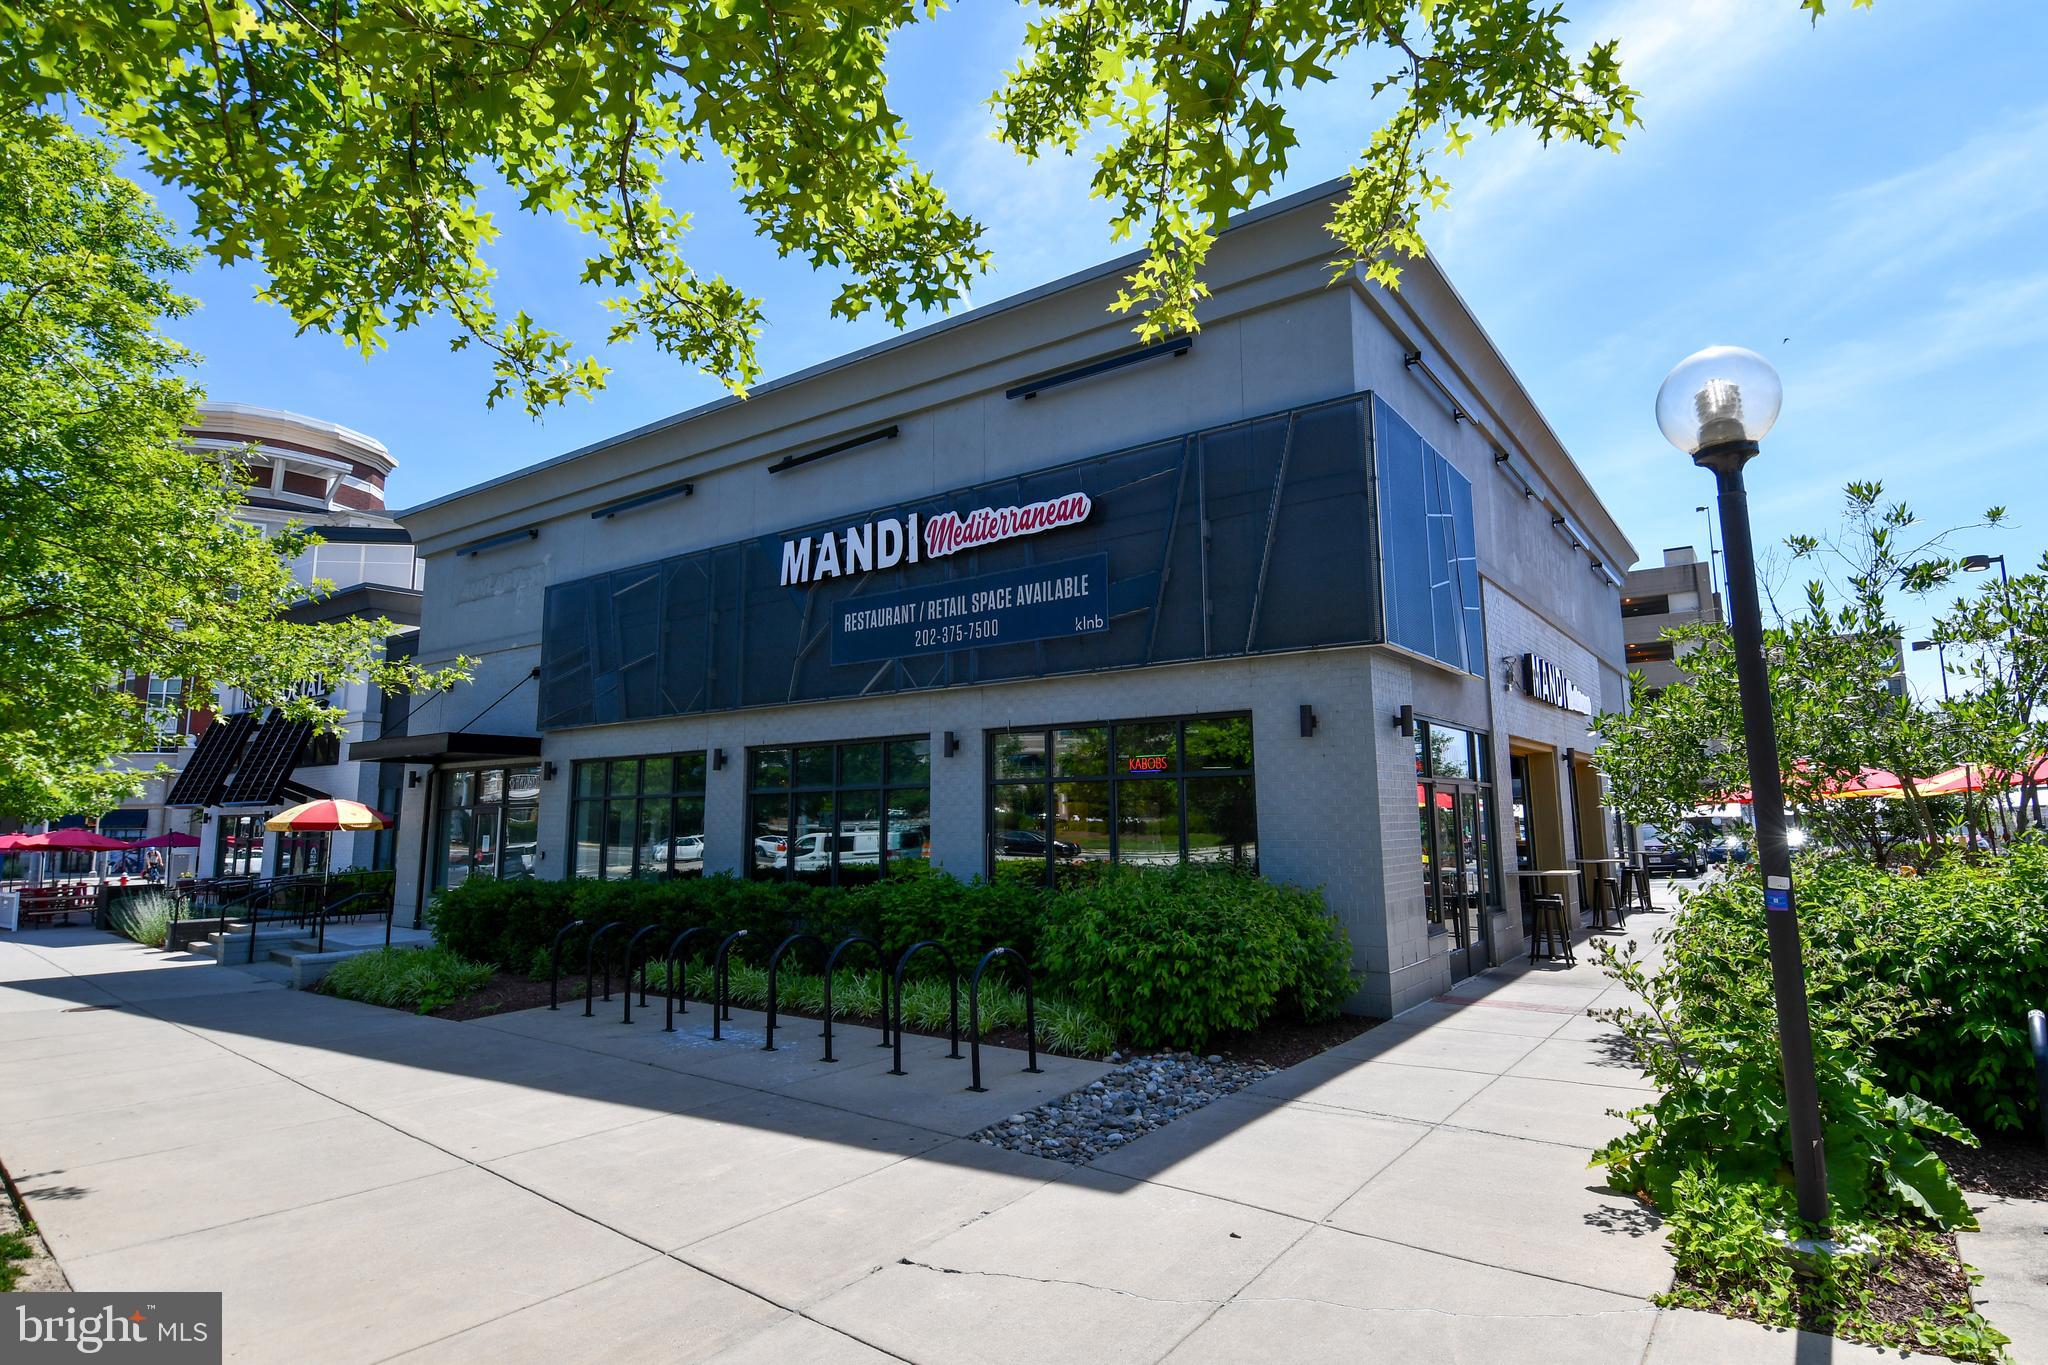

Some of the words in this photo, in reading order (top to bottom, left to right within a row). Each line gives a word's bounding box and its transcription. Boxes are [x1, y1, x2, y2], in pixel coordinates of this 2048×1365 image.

[780, 512, 919, 587] MANDI
[925, 492, 1091, 557] Mediterranean
[843, 603, 917, 633] RESTAURANT
[919, 603, 925, 622] /
[927, 593, 968, 620] RETAIL
[971, 587, 1013, 614] SPACE
[1016, 574, 1090, 606] AVAILABLE
[1075, 615, 1104, 632] klnb
[914, 619, 1000, 647] 202-375-7500
[1530, 653, 1567, 709] MANDI
[1129, 756, 1168, 770] KABOBS
